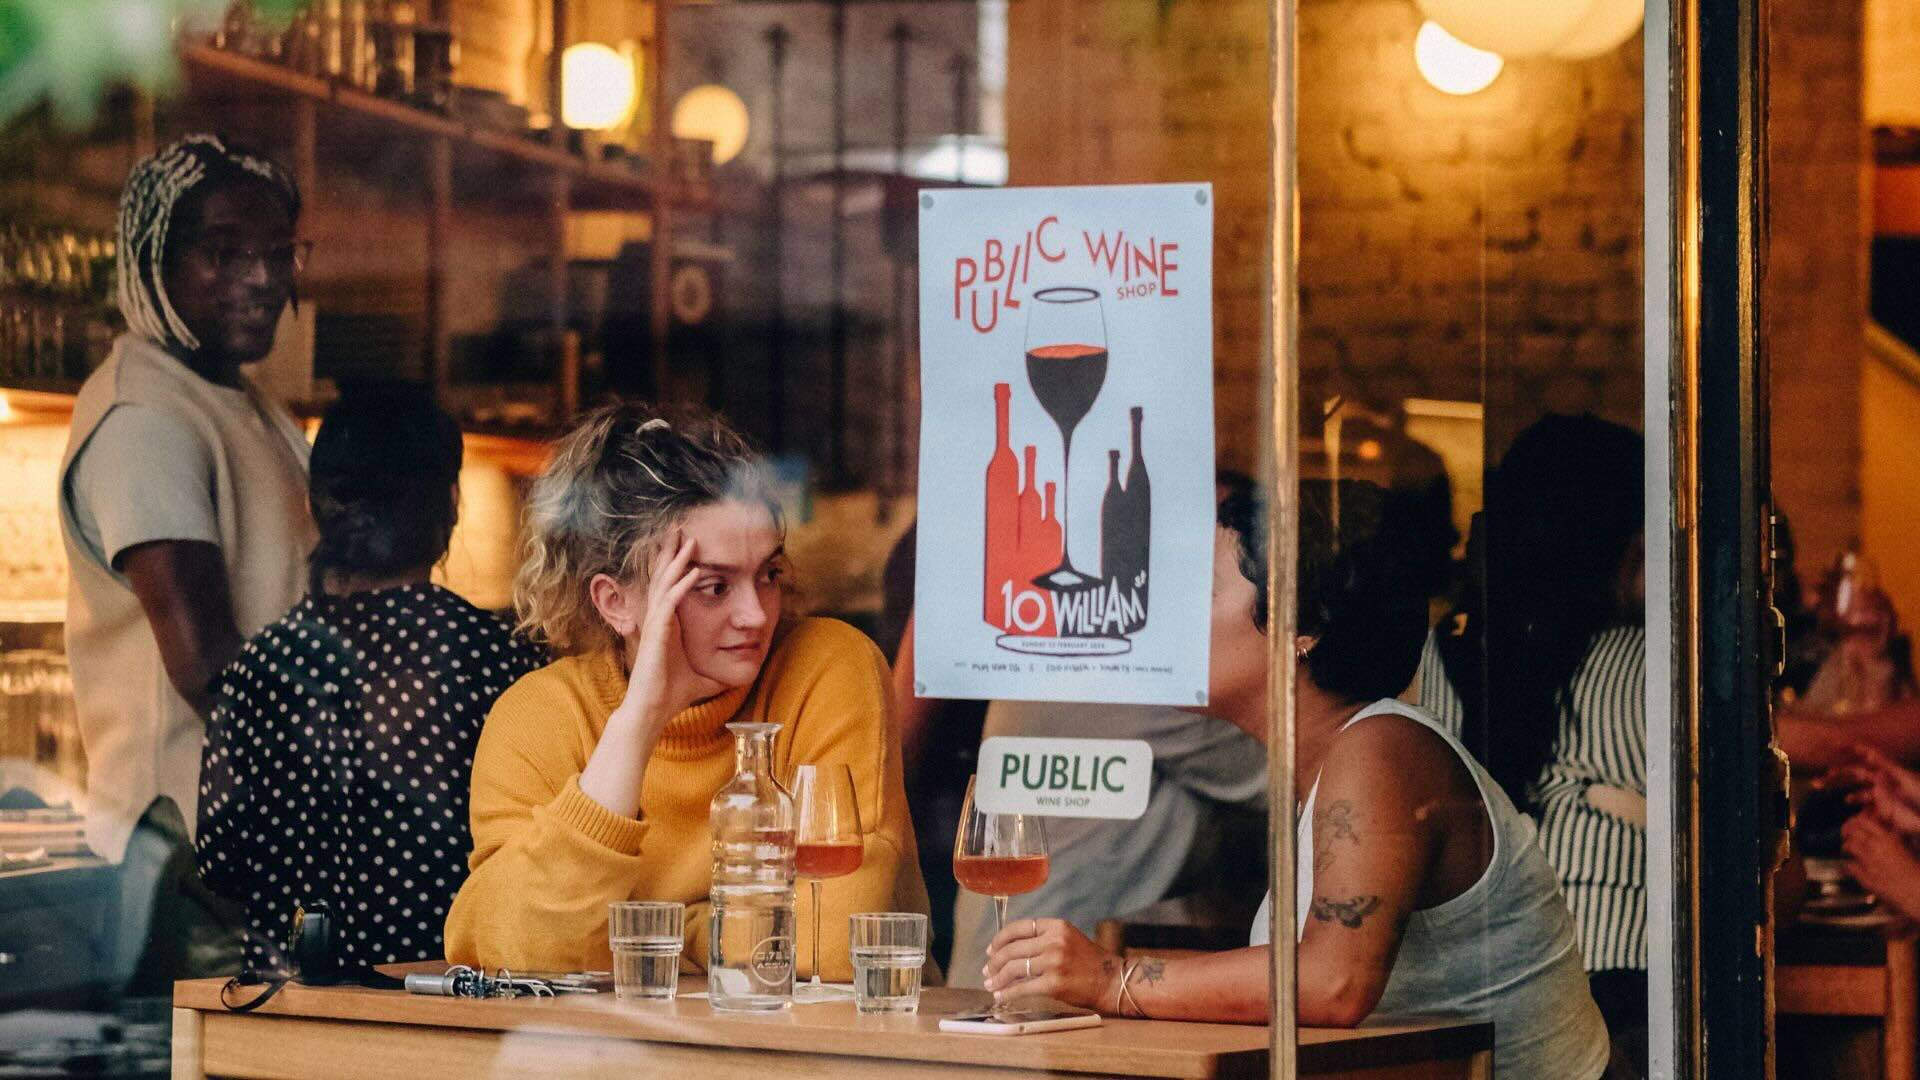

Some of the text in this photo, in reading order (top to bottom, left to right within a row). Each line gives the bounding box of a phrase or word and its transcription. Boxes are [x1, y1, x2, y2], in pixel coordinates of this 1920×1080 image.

[954, 216, 1179, 333] PUBLIC WINE
[1116, 283, 1157, 301] SHOP
[1001, 579, 1048, 633] 10
[1000, 753, 1127, 792] PUBLIC
[1036, 796, 1091, 808] WINE SHOP
